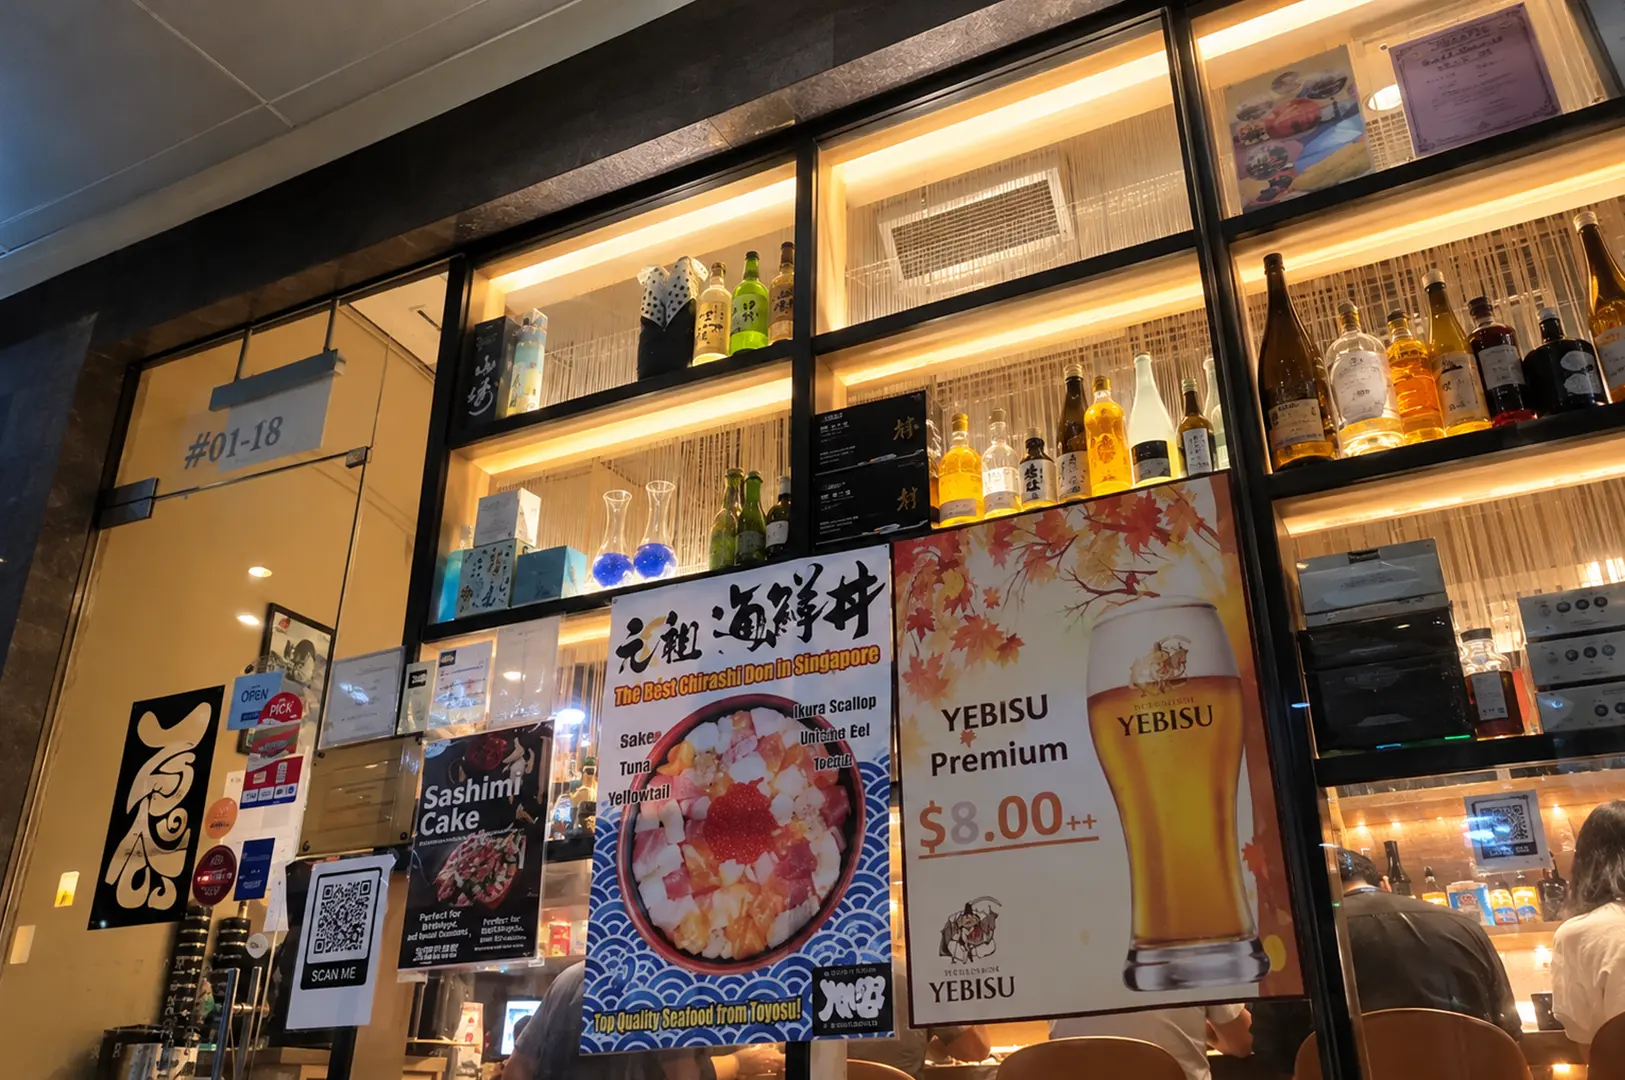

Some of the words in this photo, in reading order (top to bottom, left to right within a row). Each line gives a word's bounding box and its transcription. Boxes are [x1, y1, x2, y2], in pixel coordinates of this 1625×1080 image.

[184, 416, 283, 470] #01-18
[615, 684, 641, 707] The
[643, 677, 677, 702] Best
[679, 665, 742, 696] Chirashi
[743, 663, 774, 685] Don
[775, 658, 792, 679] in
[793, 644, 881, 676] Singapore
[241, 688, 269, 703] OPEN
[269, 702, 293, 717] PICK
[794, 703, 825, 719] Ikura
[829, 696, 876, 714] Scallop
[941, 694, 1048, 733] YEBISU
[1117, 704, 1213, 736] YEBISU
[850, 722, 870, 739] Eel
[619, 760, 651, 776] Tuna
[930, 740, 1069, 777] Premium
[423, 772, 521, 809] Sashimi
[608, 783, 670, 806] Yellowtail
[420, 807, 480, 836] Cake
[311, 968, 339, 982] SCAN
[340, 966, 357, 980] ME
[928, 976, 1015, 1003] YEBISU
[594, 1013, 615, 1034] Top
[617, 1009, 660, 1033] Quality
[661, 1004, 714, 1029] Seafood
[716, 1003, 748, 1025] from
[749, 998, 802, 1024] Toyosu!
